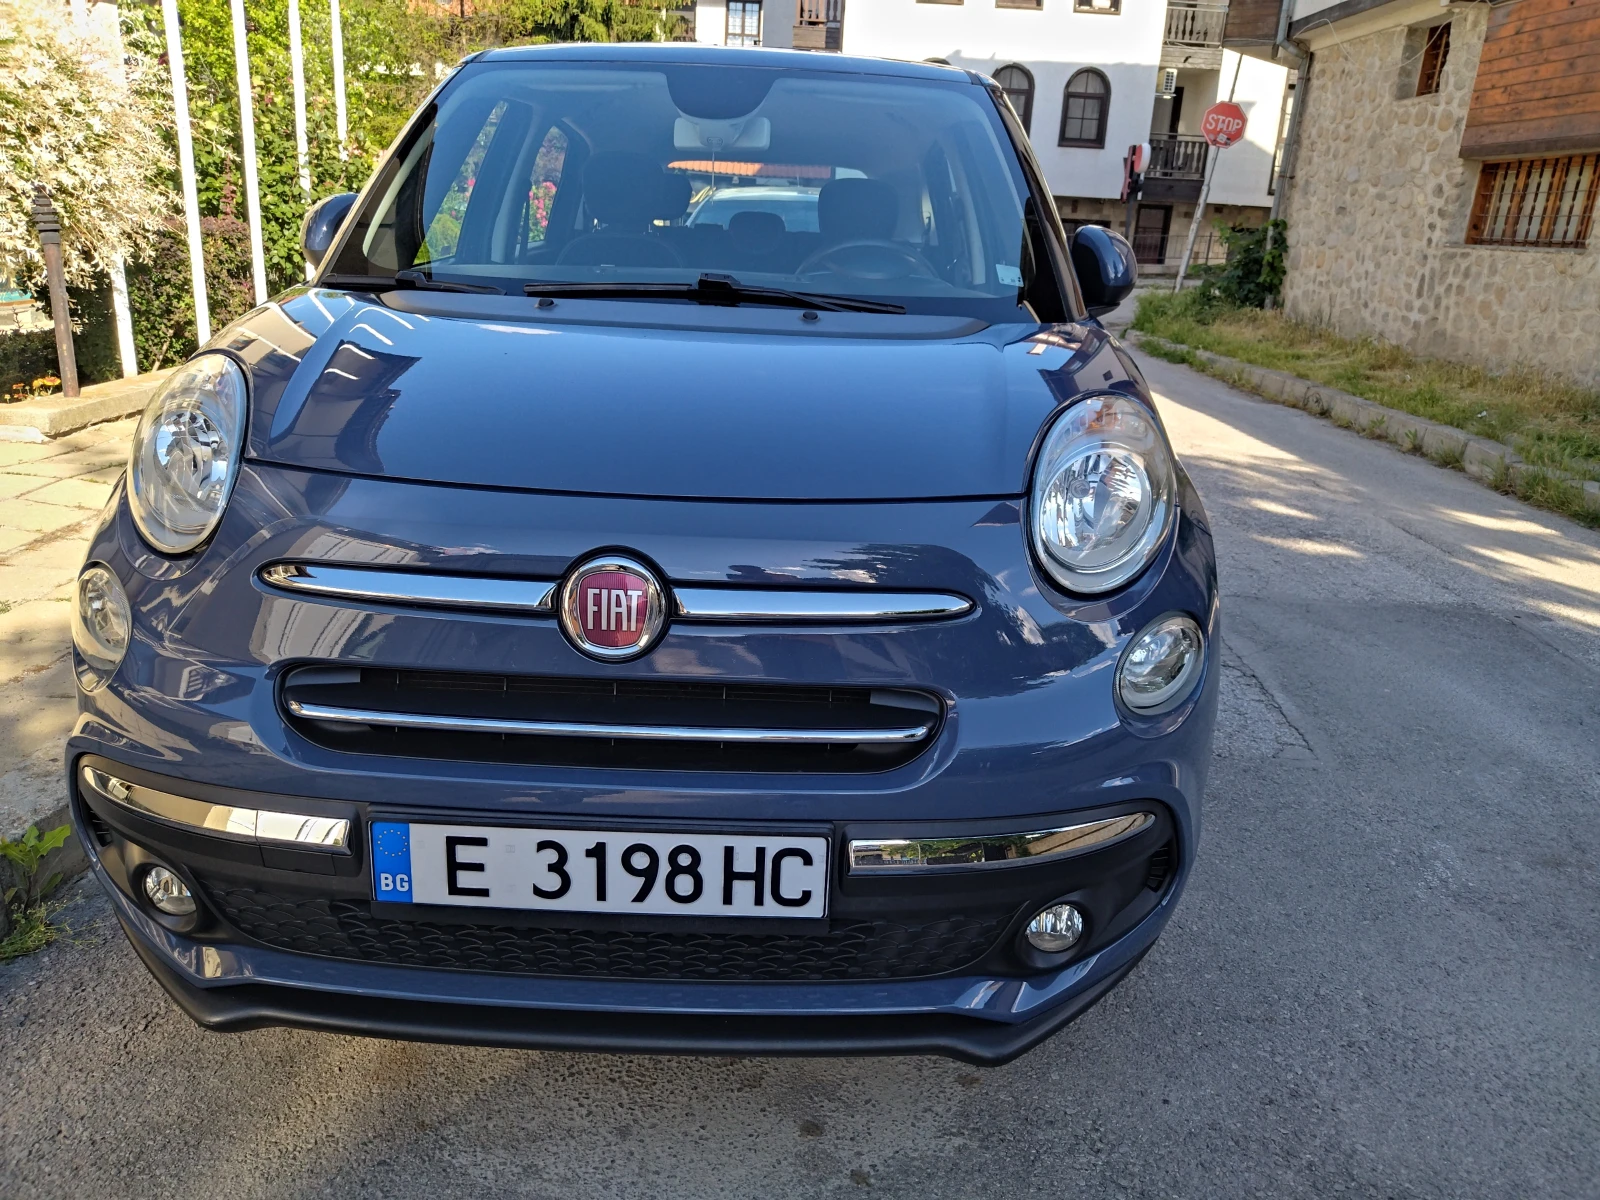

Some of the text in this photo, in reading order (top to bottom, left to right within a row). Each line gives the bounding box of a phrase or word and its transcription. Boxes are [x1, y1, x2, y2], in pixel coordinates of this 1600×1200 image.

[1206, 114, 1242, 131] STOP
[587, 588, 643, 632] FIAT
[380, 873, 409, 892] BG
[445, 835, 814, 907] E 3198 HC
